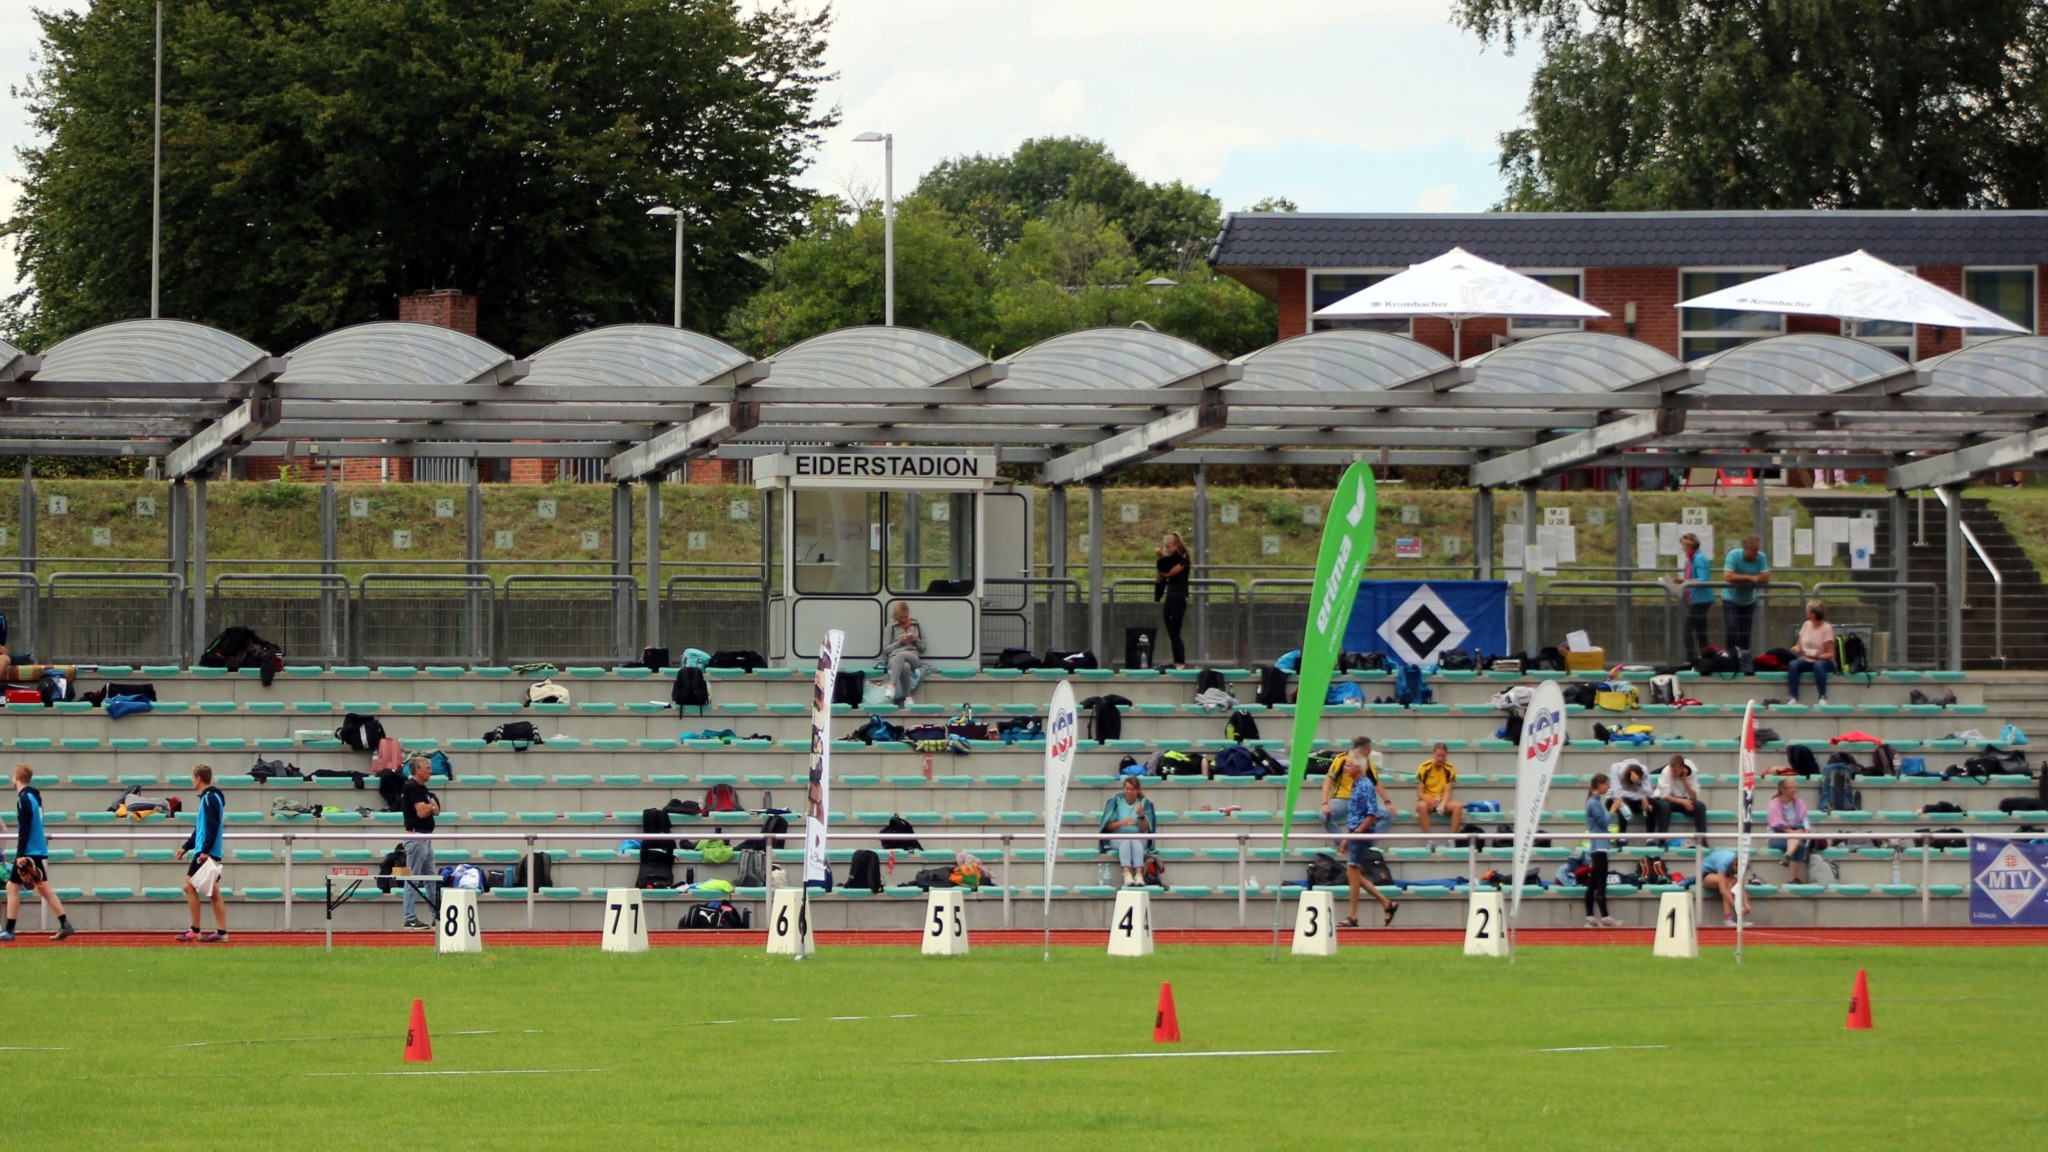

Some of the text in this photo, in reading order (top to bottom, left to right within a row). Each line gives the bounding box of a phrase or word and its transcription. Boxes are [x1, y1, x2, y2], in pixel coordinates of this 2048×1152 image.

[1750, 298, 1813, 308] Krombacher
[796, 456, 978, 476] EIDERSTADION
[1316, 534, 1352, 635] erima
[1519, 773, 1547, 864] www.shlv.de
[1988, 871, 2032, 888] MTV
[445, 904, 458, 937] 8
[467, 904, 476, 937] 8
[610, 904, 622, 935] 7
[776, 905, 788, 937] 6
[931, 905, 944, 937] 5
[953, 905, 962, 937] 5
[1118, 906, 1133, 937] 4
[1143, 906, 1149, 937] 4
[1304, 906, 1318, 937] 3
[1475, 907, 1489, 938] 2
[1665, 907, 1676, 938] 1
